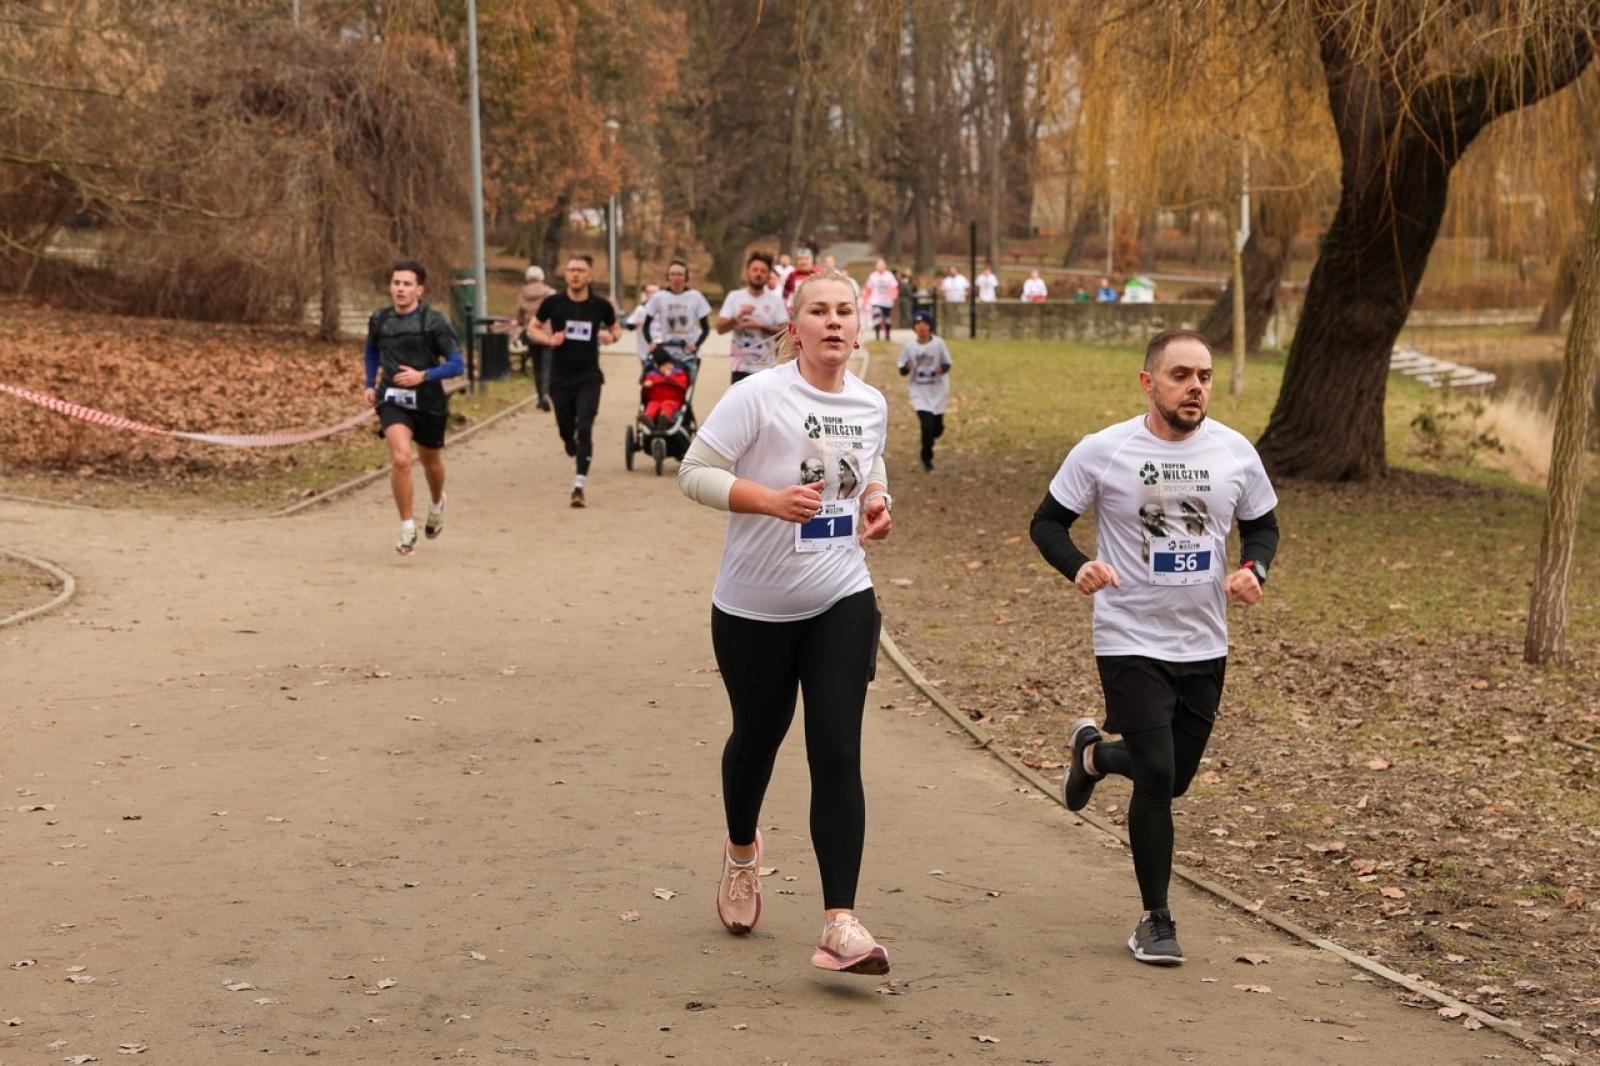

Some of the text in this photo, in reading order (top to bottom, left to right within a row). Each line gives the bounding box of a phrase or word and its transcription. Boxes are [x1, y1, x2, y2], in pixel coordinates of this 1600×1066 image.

[824, 424, 862, 436] WILCZYM
[1162, 469, 1209, 480] WILCZYM
[827, 518, 835, 537] 1
[1174, 553, 1198, 571] 56
